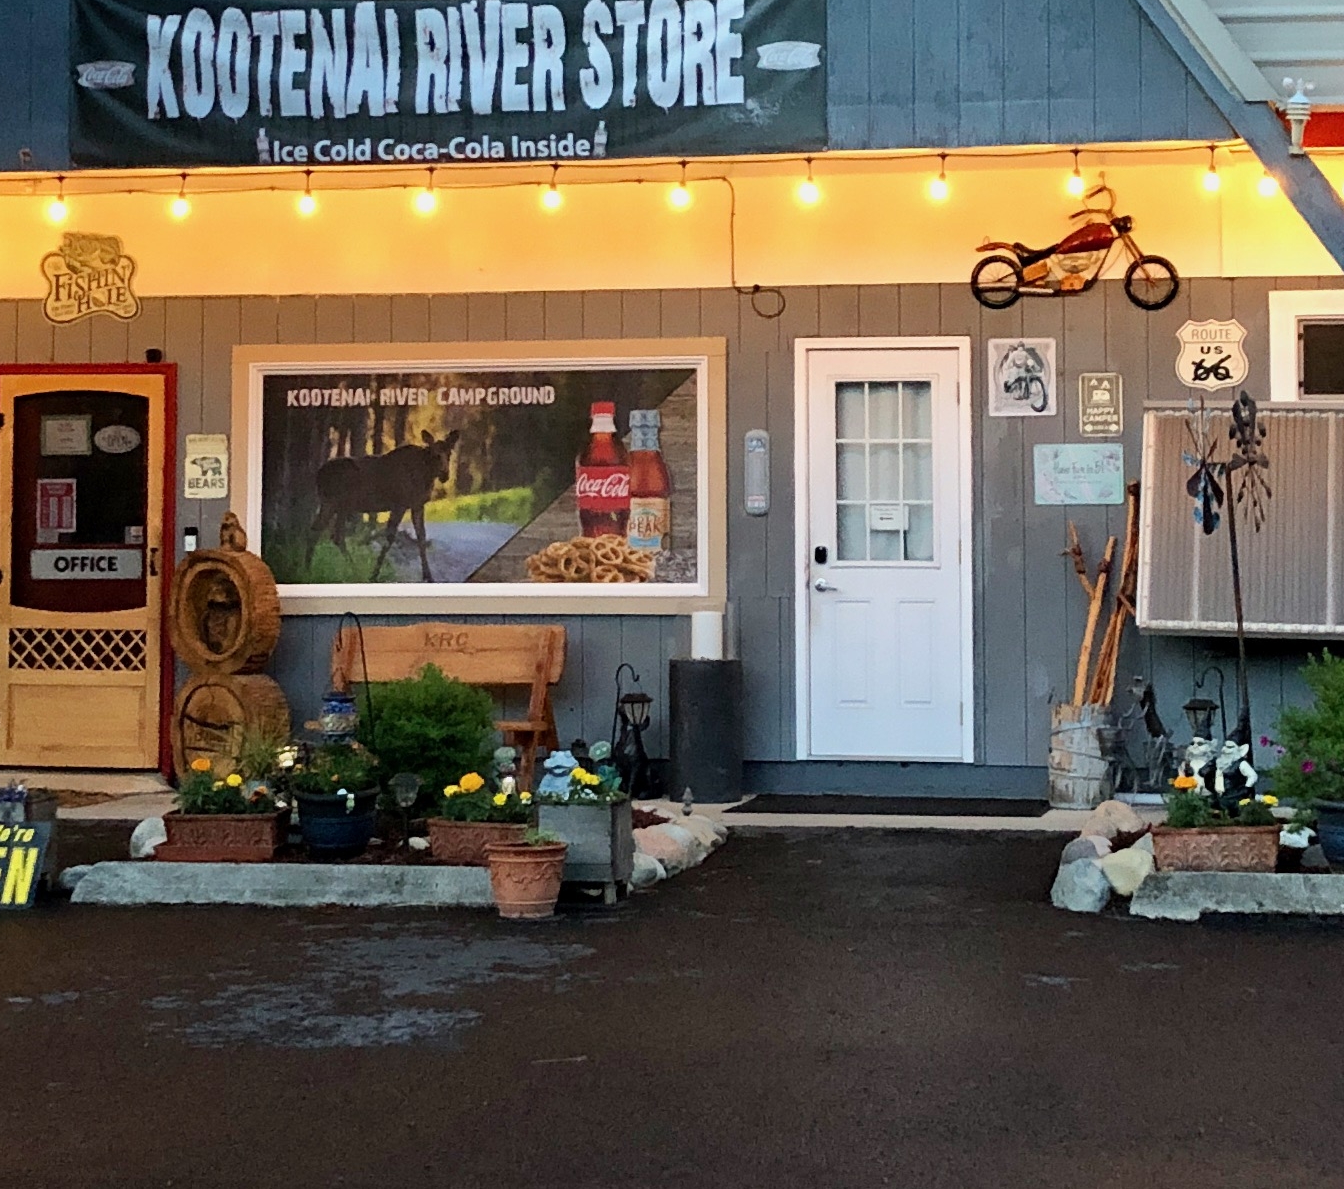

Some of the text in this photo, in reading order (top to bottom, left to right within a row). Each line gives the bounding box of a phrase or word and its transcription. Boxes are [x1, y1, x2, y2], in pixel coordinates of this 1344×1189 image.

[147, 1, 401, 120] KOOTENAI
[415, 0, 566, 115] RIVER
[273, 132, 591, 162] Ice Cold Coca-Cola Inside
[1191, 328, 1232, 340] ROUTE
[287, 386, 556, 407] KOOTENAI RIVER CAMPGROUND
[188, 477, 225, 489] BEARS
[576, 473, 630, 498] Coca-Cola
[54, 556, 119, 572] OFFICE
[424, 632, 469, 648] KRC
